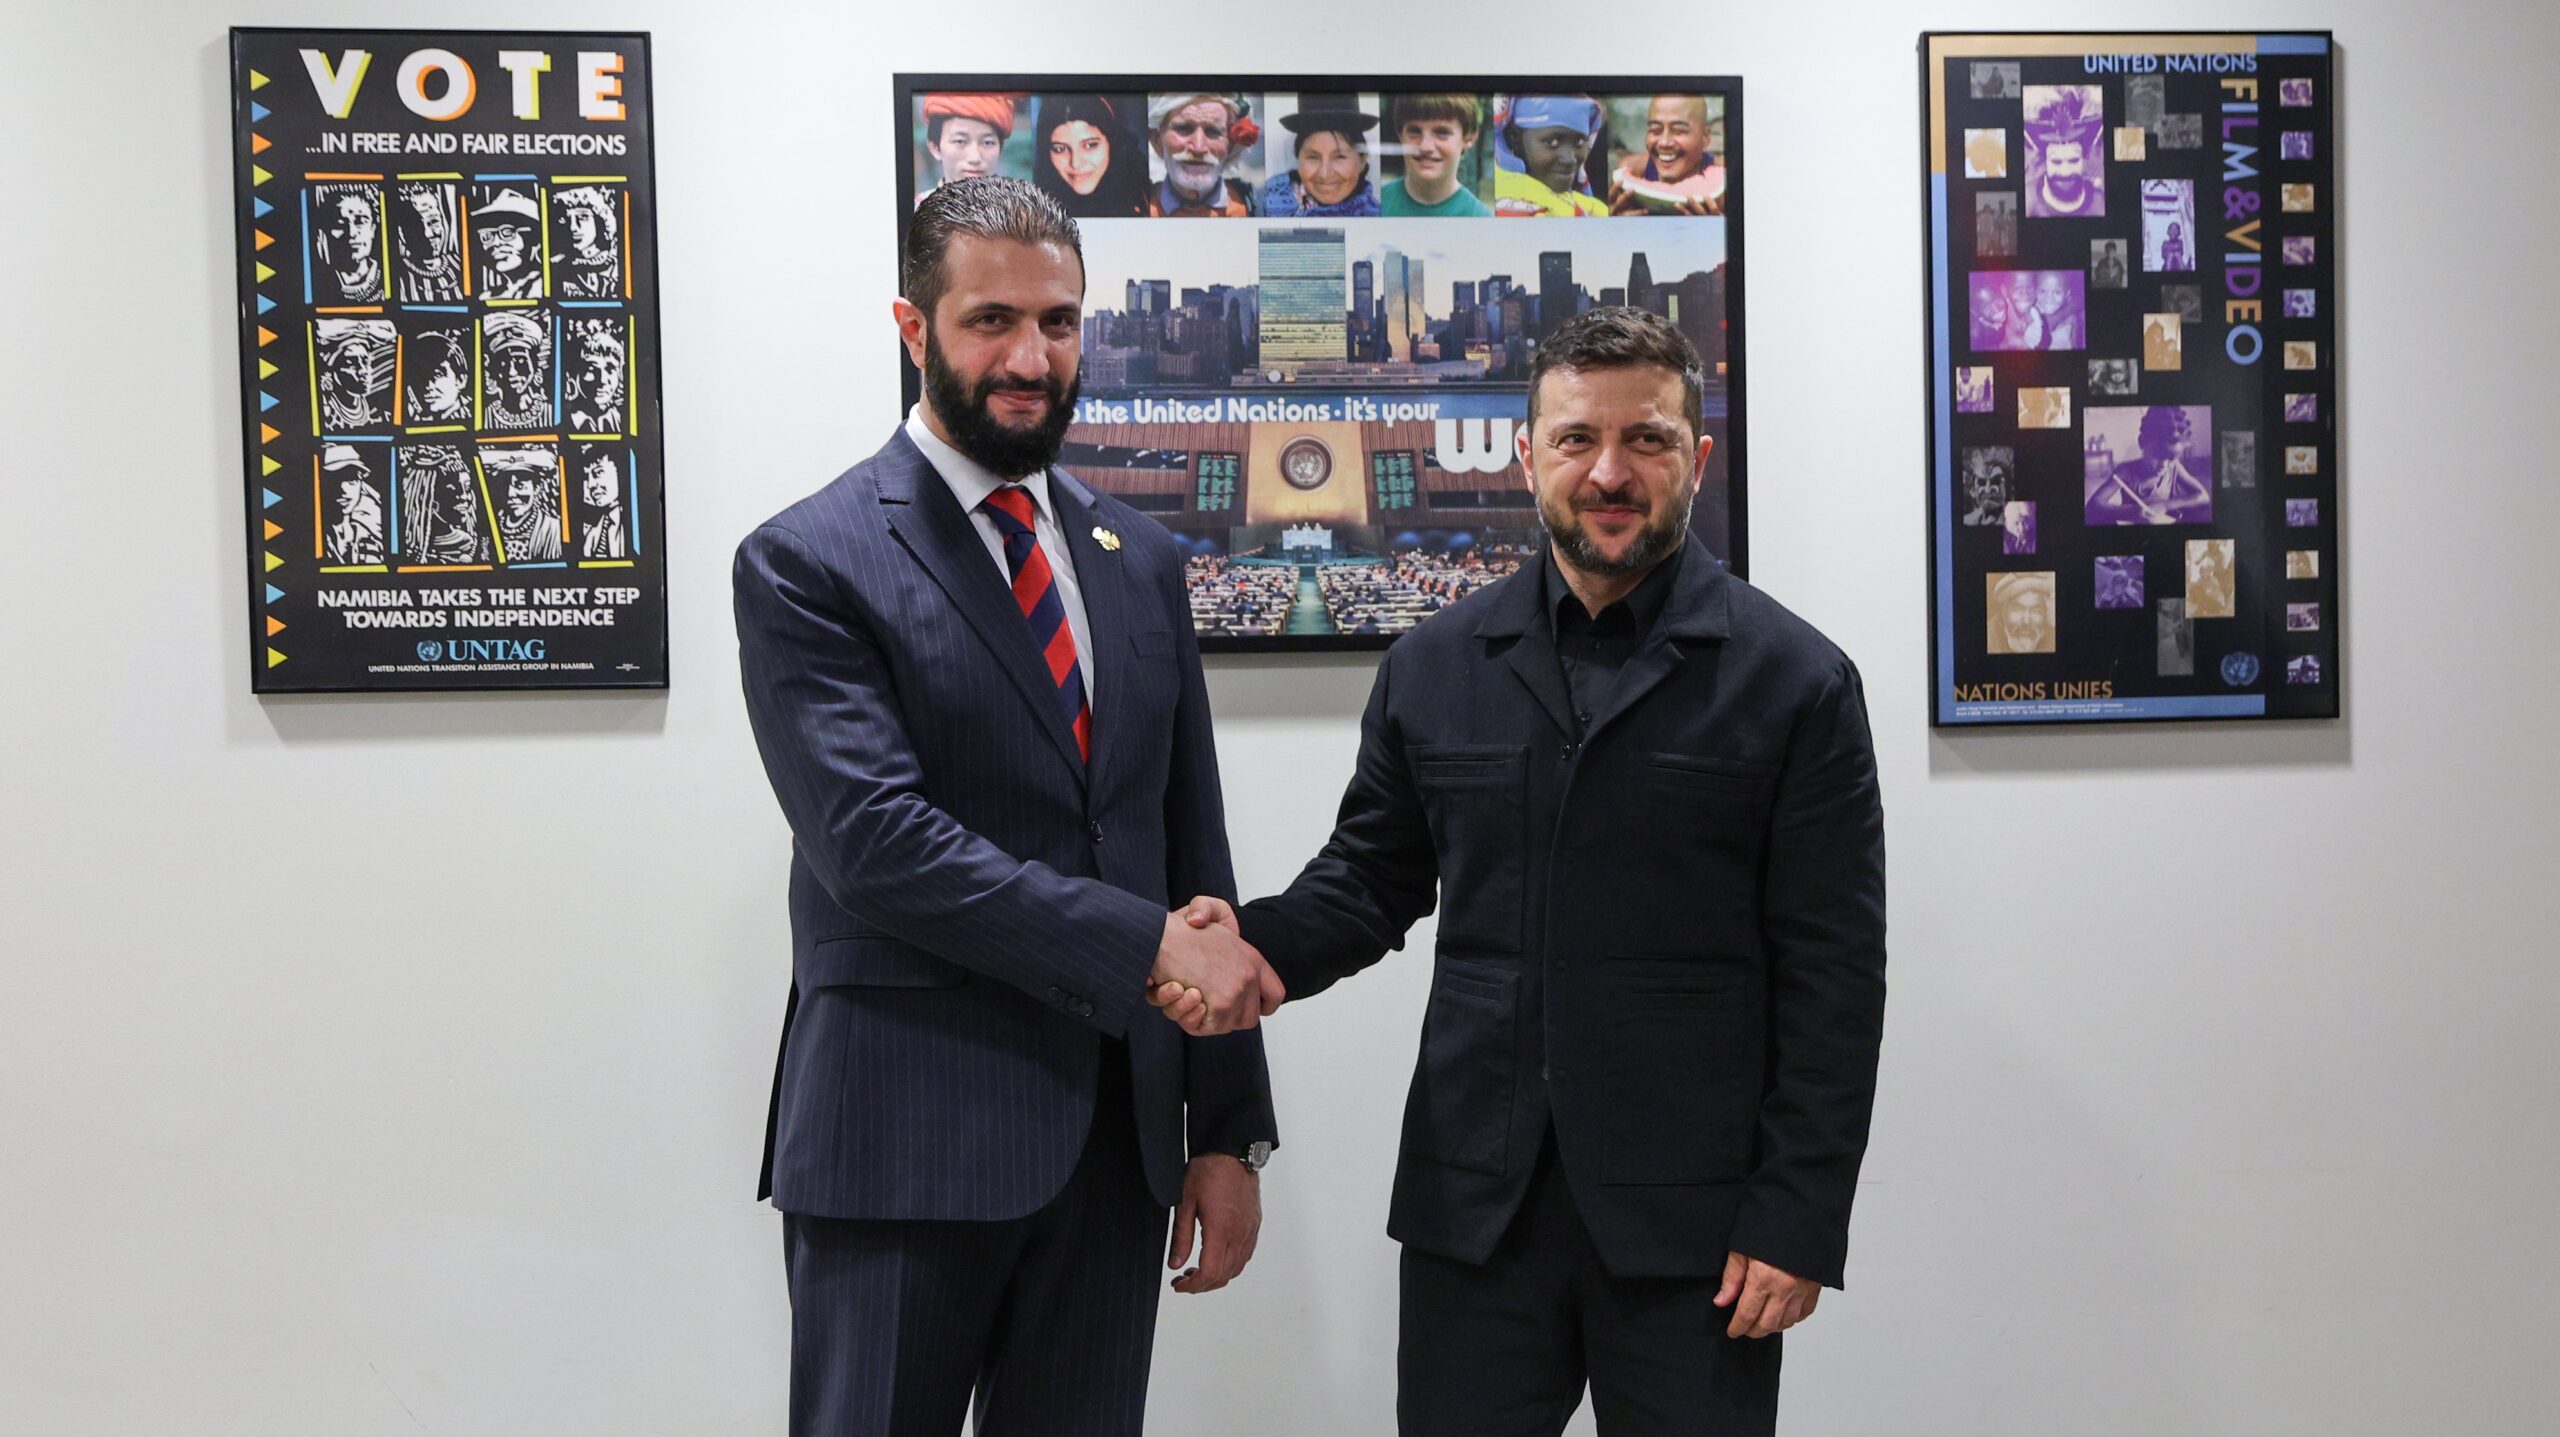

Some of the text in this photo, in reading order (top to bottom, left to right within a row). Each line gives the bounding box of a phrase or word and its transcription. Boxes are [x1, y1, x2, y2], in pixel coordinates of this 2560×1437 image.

[2084, 54, 2257, 74] UNITED NATIONS
[299, 48, 627, 121] VOTE
[352, 133, 401, 153] FREE
[405, 133, 457, 154] AND
[462, 134, 510, 155] FAIR
[513, 134, 627, 156] ELECTIONS
[1085, 398, 1129, 424] the
[1133, 398, 1222, 424] United
[1228, 397, 1331, 423] Nations
[1344, 396, 1378, 422] it's
[1382, 402, 1440, 428] your
[317, 587, 641, 608] NAMIBIA TAKES THE NEXT STEP
[343, 608, 614, 629] TOWARDS INDEPENDENCE
[447, 639, 546, 662] UNTAG
[368, 662, 595, 673] UNITED NATIONS TRANSITION ASSISTANCE GROUP IN NAMIBIA
[1954, 681, 2113, 703] NATIONS UNIES
